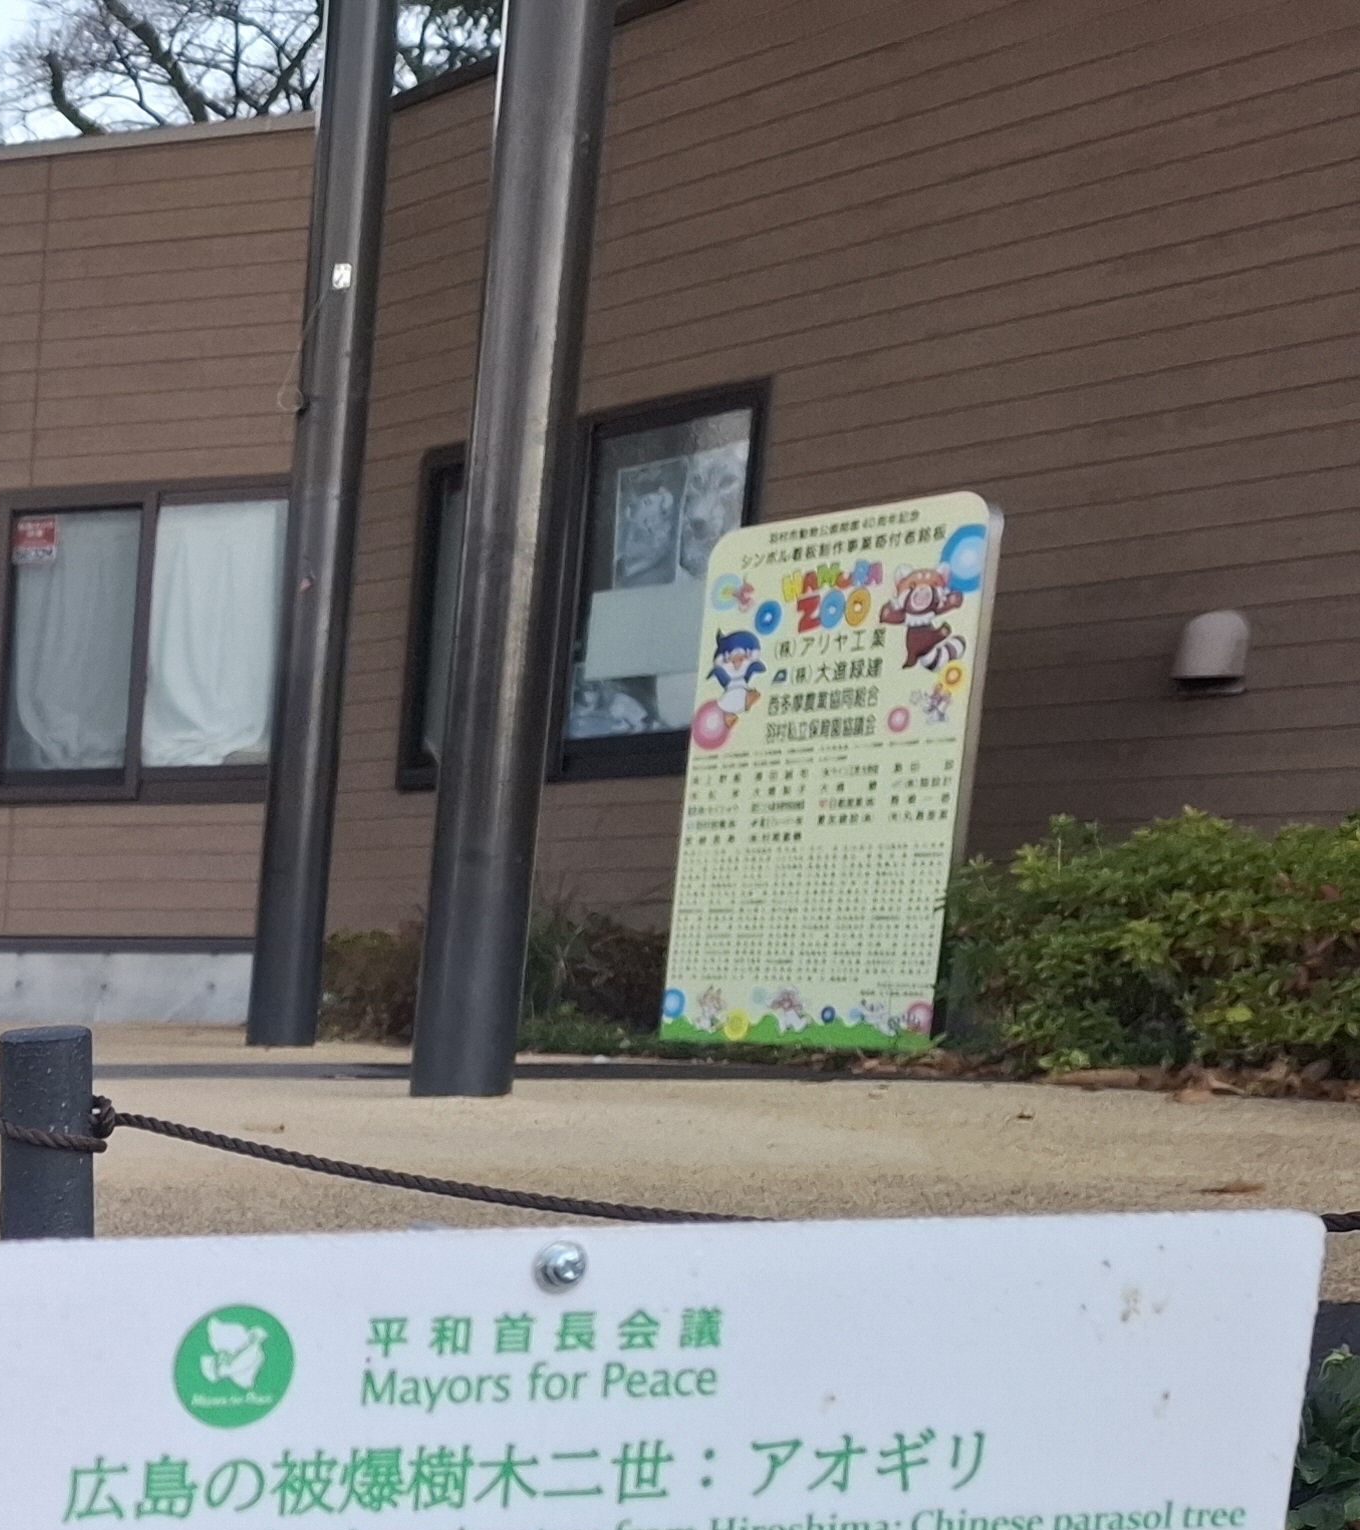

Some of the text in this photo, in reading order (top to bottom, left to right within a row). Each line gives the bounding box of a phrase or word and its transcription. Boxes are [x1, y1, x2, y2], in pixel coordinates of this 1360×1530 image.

[797, 587, 872, 633] ZOO
[366, 1307, 724, 1357] 平和首長会議
[360, 1361, 719, 1413] Mayors for Peace
[61, 1427, 988, 1523] 広島の被爆樹木二世：アオギリ
[1183, 1503, 1247, 1529] tree
